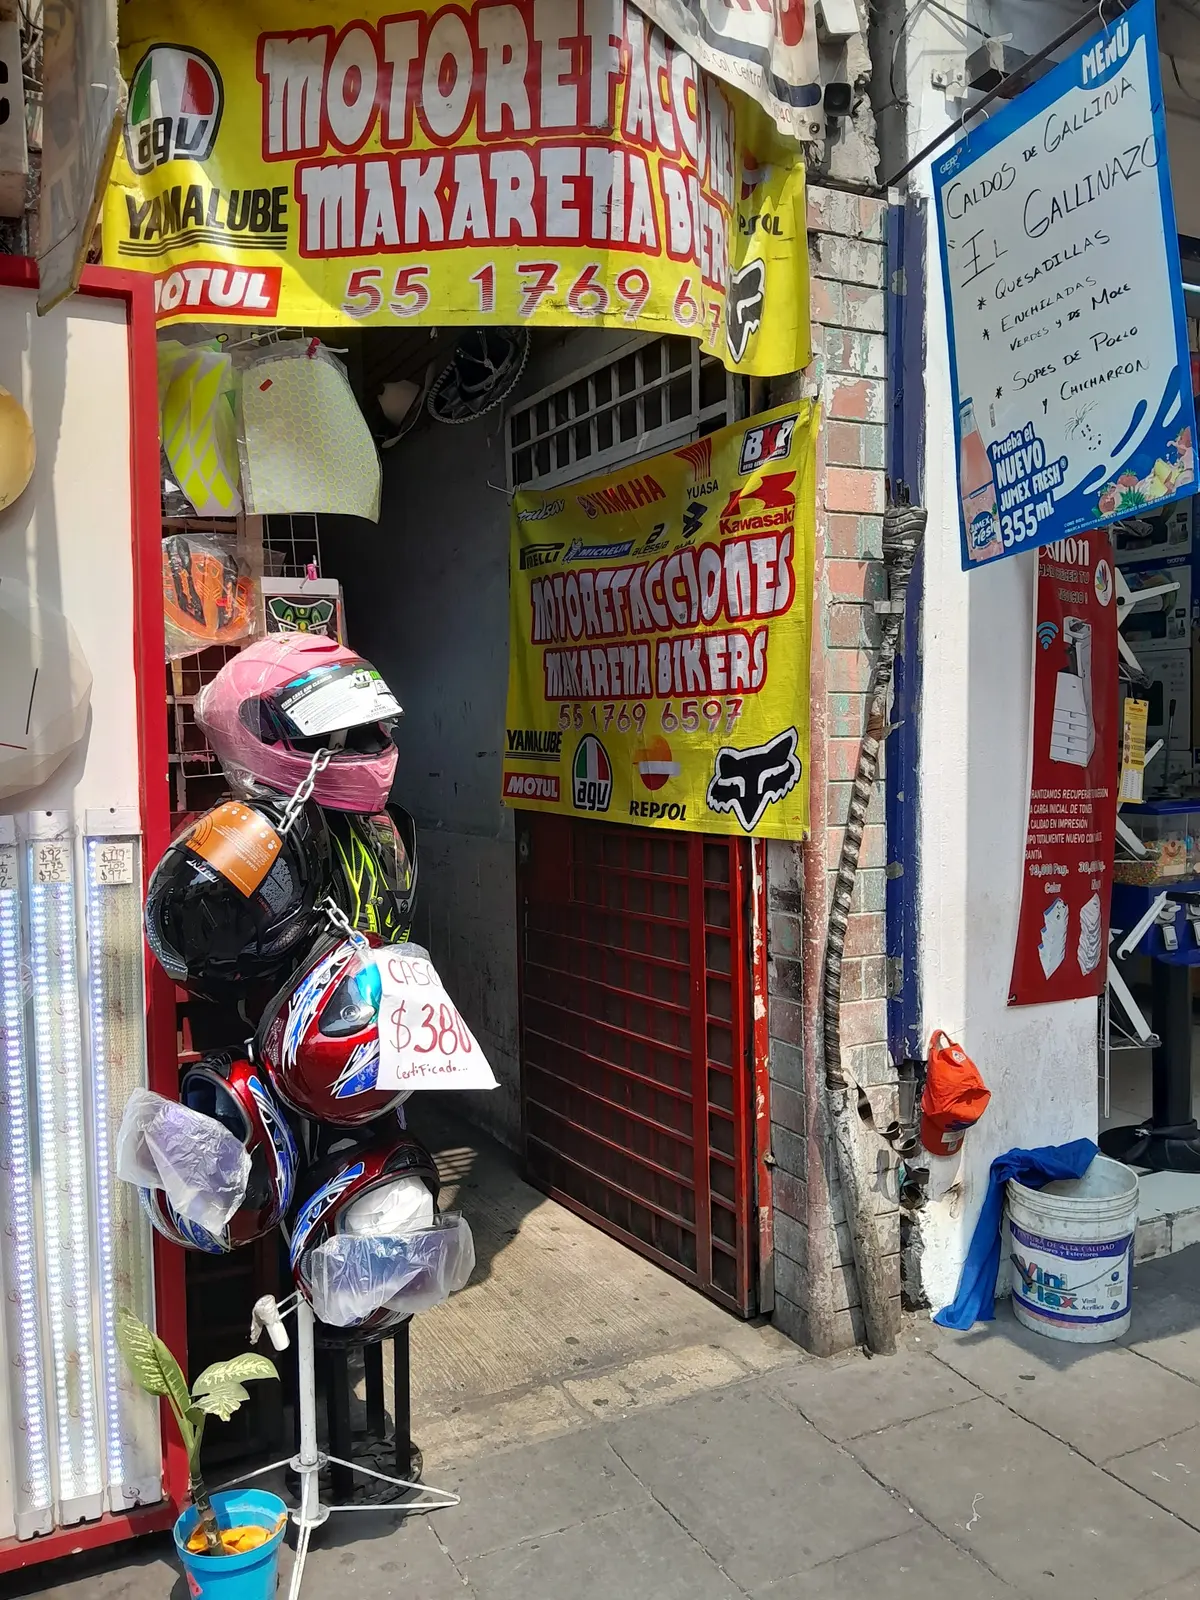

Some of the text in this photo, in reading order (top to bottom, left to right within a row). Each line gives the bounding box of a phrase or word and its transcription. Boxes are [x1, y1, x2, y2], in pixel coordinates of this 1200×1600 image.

[1081, 19, 1130, 85] MENÚ
[257, 0, 735, 215] MOTOREFACCN
[137, 115, 210, 166] agv
[945, 162, 1017, 220] CALDOS
[1043, 77, 1137, 153] GALLINA
[124, 184, 289, 241] YAMALUBE
[735, 202, 784, 237] PSOL
[994, 228, 1111, 300] QUESADILLAS
[341, 264, 431, 319] 55
[672, 275, 721, 348] 67
[1000, 275, 1098, 333] ENCHILADAS
[1012, 363, 1057, 392] SOPES
[1089, 326, 1139, 352] POLLO
[1059, 357, 1151, 402] CHICHARRON
[991, 424, 1034, 461] Prueba el
[995, 440, 1043, 490] NUEVO
[590, 474, 667, 515] YAMAHA
[686, 479, 719, 500] YUASA
[1000, 479, 1032, 513] JUMEX
[719, 505, 796, 536] Kawasaki
[580, 541, 633, 558] MICHELIN
[530, 526, 796, 645] MOTOREFACCIONES
[544, 624, 769, 702] MAKARENA BIKERS
[660, 697, 744, 734] 6597
[506, 729, 563, 754] YAMALUBE
[506, 775, 559, 798] MOTUL
[576, 780, 610, 812] agv
[629, 800, 687, 821] REPSOL
[1069, 803, 1078, 814] DE
[1065, 1250, 1099, 1258] Exteriores
[1081, 1243, 1115, 1253] CALIDAD
